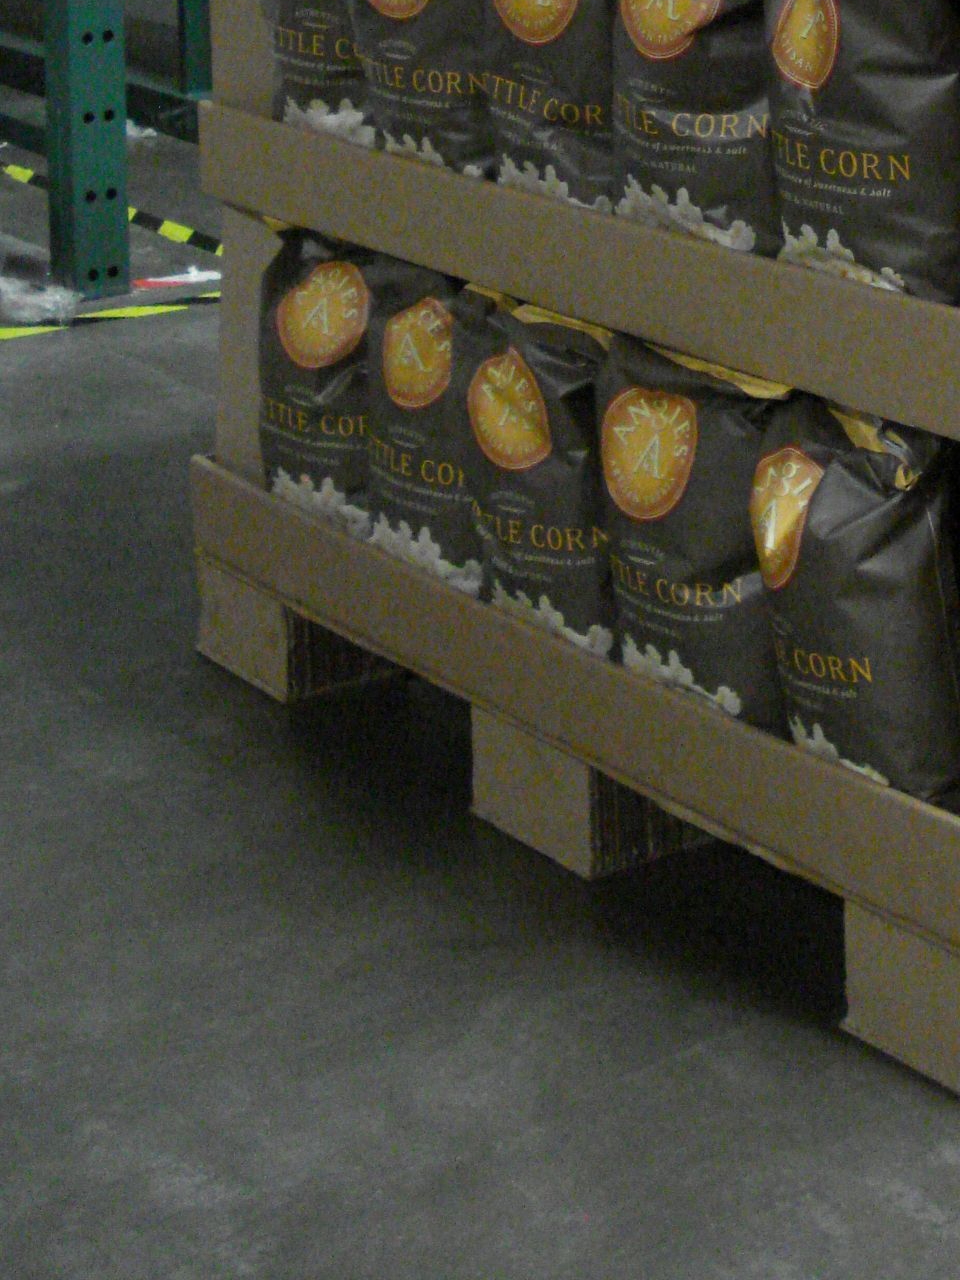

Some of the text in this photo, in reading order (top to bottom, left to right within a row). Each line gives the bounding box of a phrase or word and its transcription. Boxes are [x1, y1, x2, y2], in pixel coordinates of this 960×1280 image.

[411, 67, 489, 95] CORN
[671, 113, 768, 139] CORN
[819, 148, 911, 182] CORN
[870, 186, 892, 198] salt
[530, 523, 610, 552] CORN
[655, 577, 742, 608] CORN
[793, 647, 874, 685] CORN
